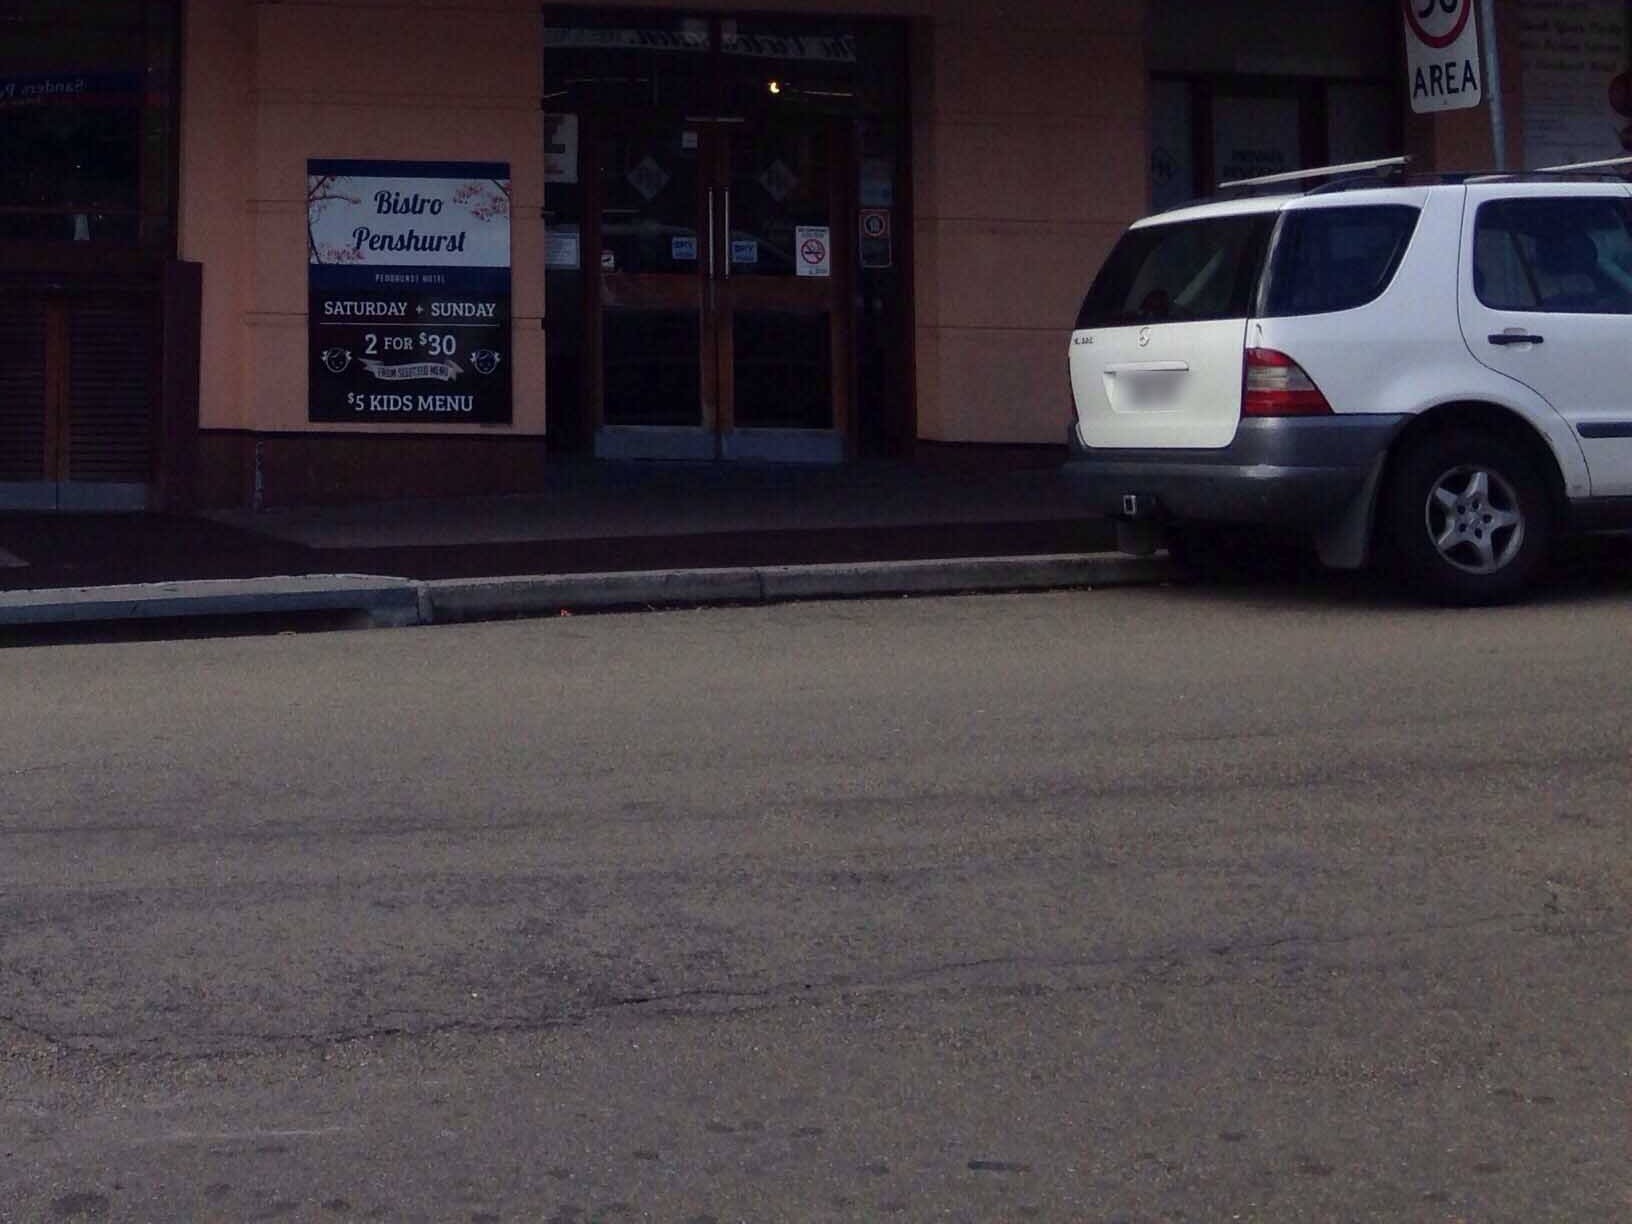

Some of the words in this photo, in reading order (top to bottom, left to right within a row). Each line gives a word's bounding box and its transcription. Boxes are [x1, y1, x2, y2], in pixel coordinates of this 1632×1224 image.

[1413, 59, 1478, 98] AREA
[374, 189, 444, 215] Bistro
[352, 226, 466, 252] Penshurst
[324, 301, 408, 316] SATURDAY
[431, 302, 497, 317] SUNDAY
[365, 333, 377, 354] 2
[384, 337, 413, 350] FOR
[419, 332, 457, 356] $30
[347, 392, 365, 411] $5
[370, 395, 413, 411] KIDS
[418, 396, 474, 412] MENU
